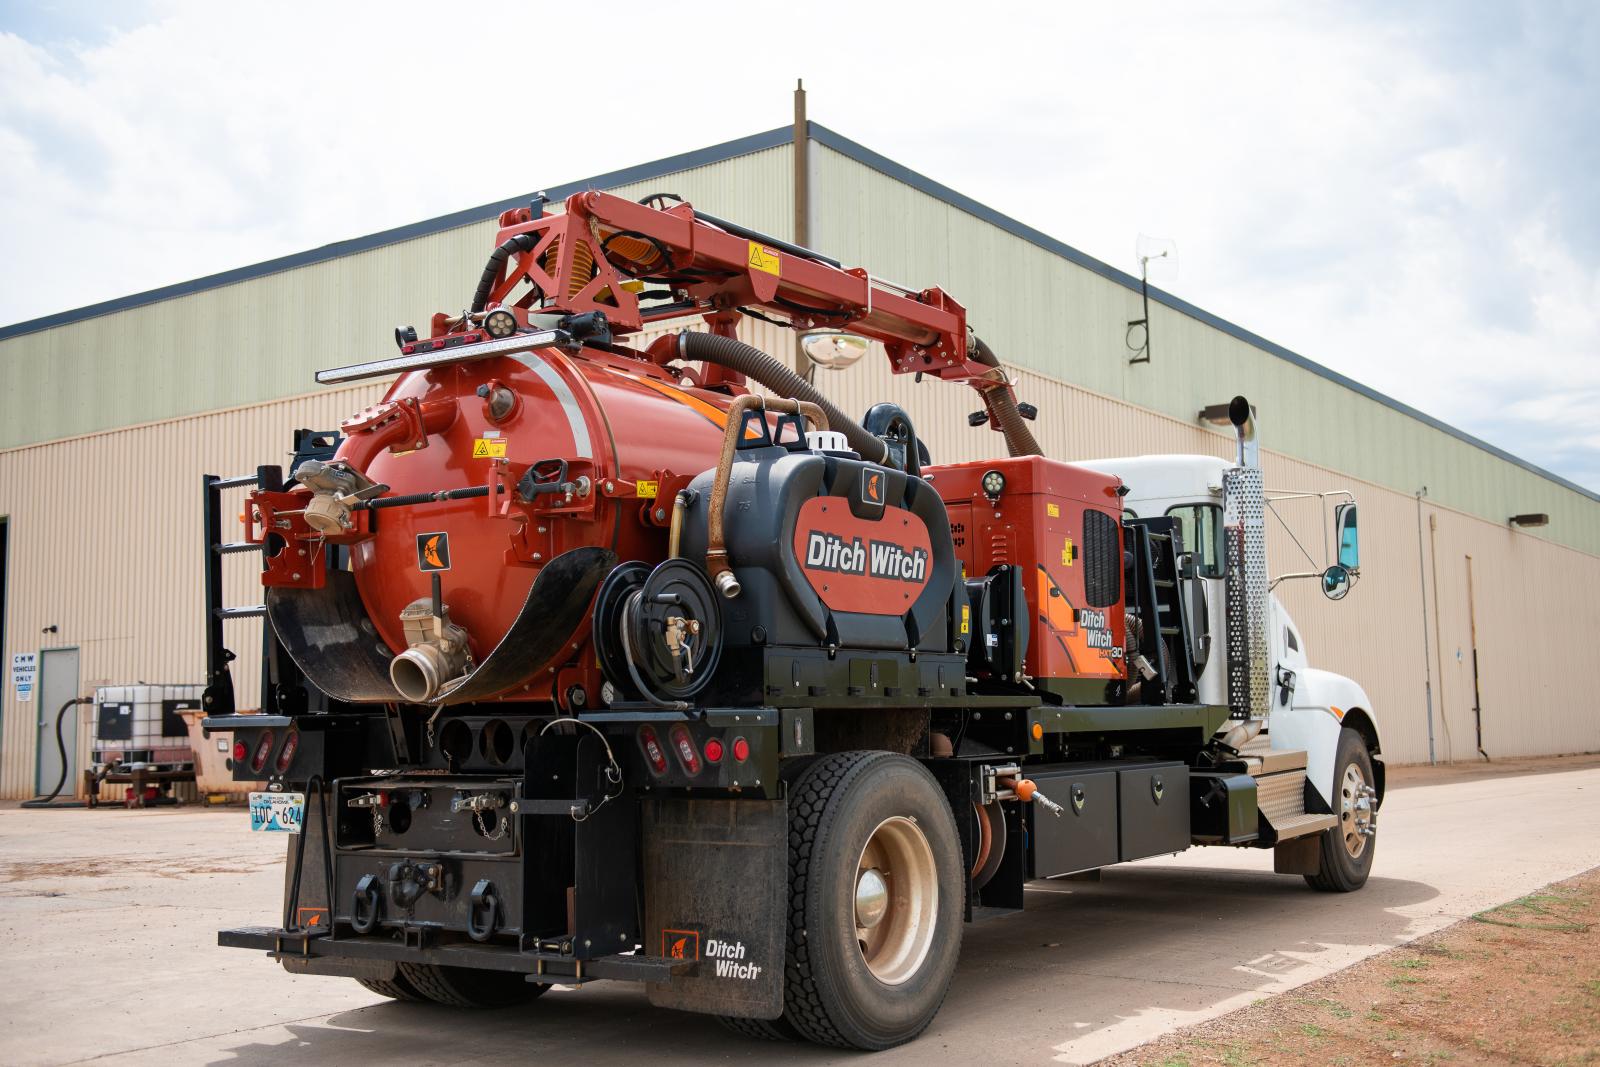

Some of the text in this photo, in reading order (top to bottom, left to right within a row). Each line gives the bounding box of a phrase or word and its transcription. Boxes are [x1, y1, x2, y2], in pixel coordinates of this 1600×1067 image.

[807, 534, 926, 580] Ditch Witch
[1080, 609, 1105, 628] Ditch
[1087, 629, 1113, 647] Witch
[13, 665, 36, 673] VEHICLES
[705, 939, 745, 960] Ditch
[715, 959, 759, 980] Witch
